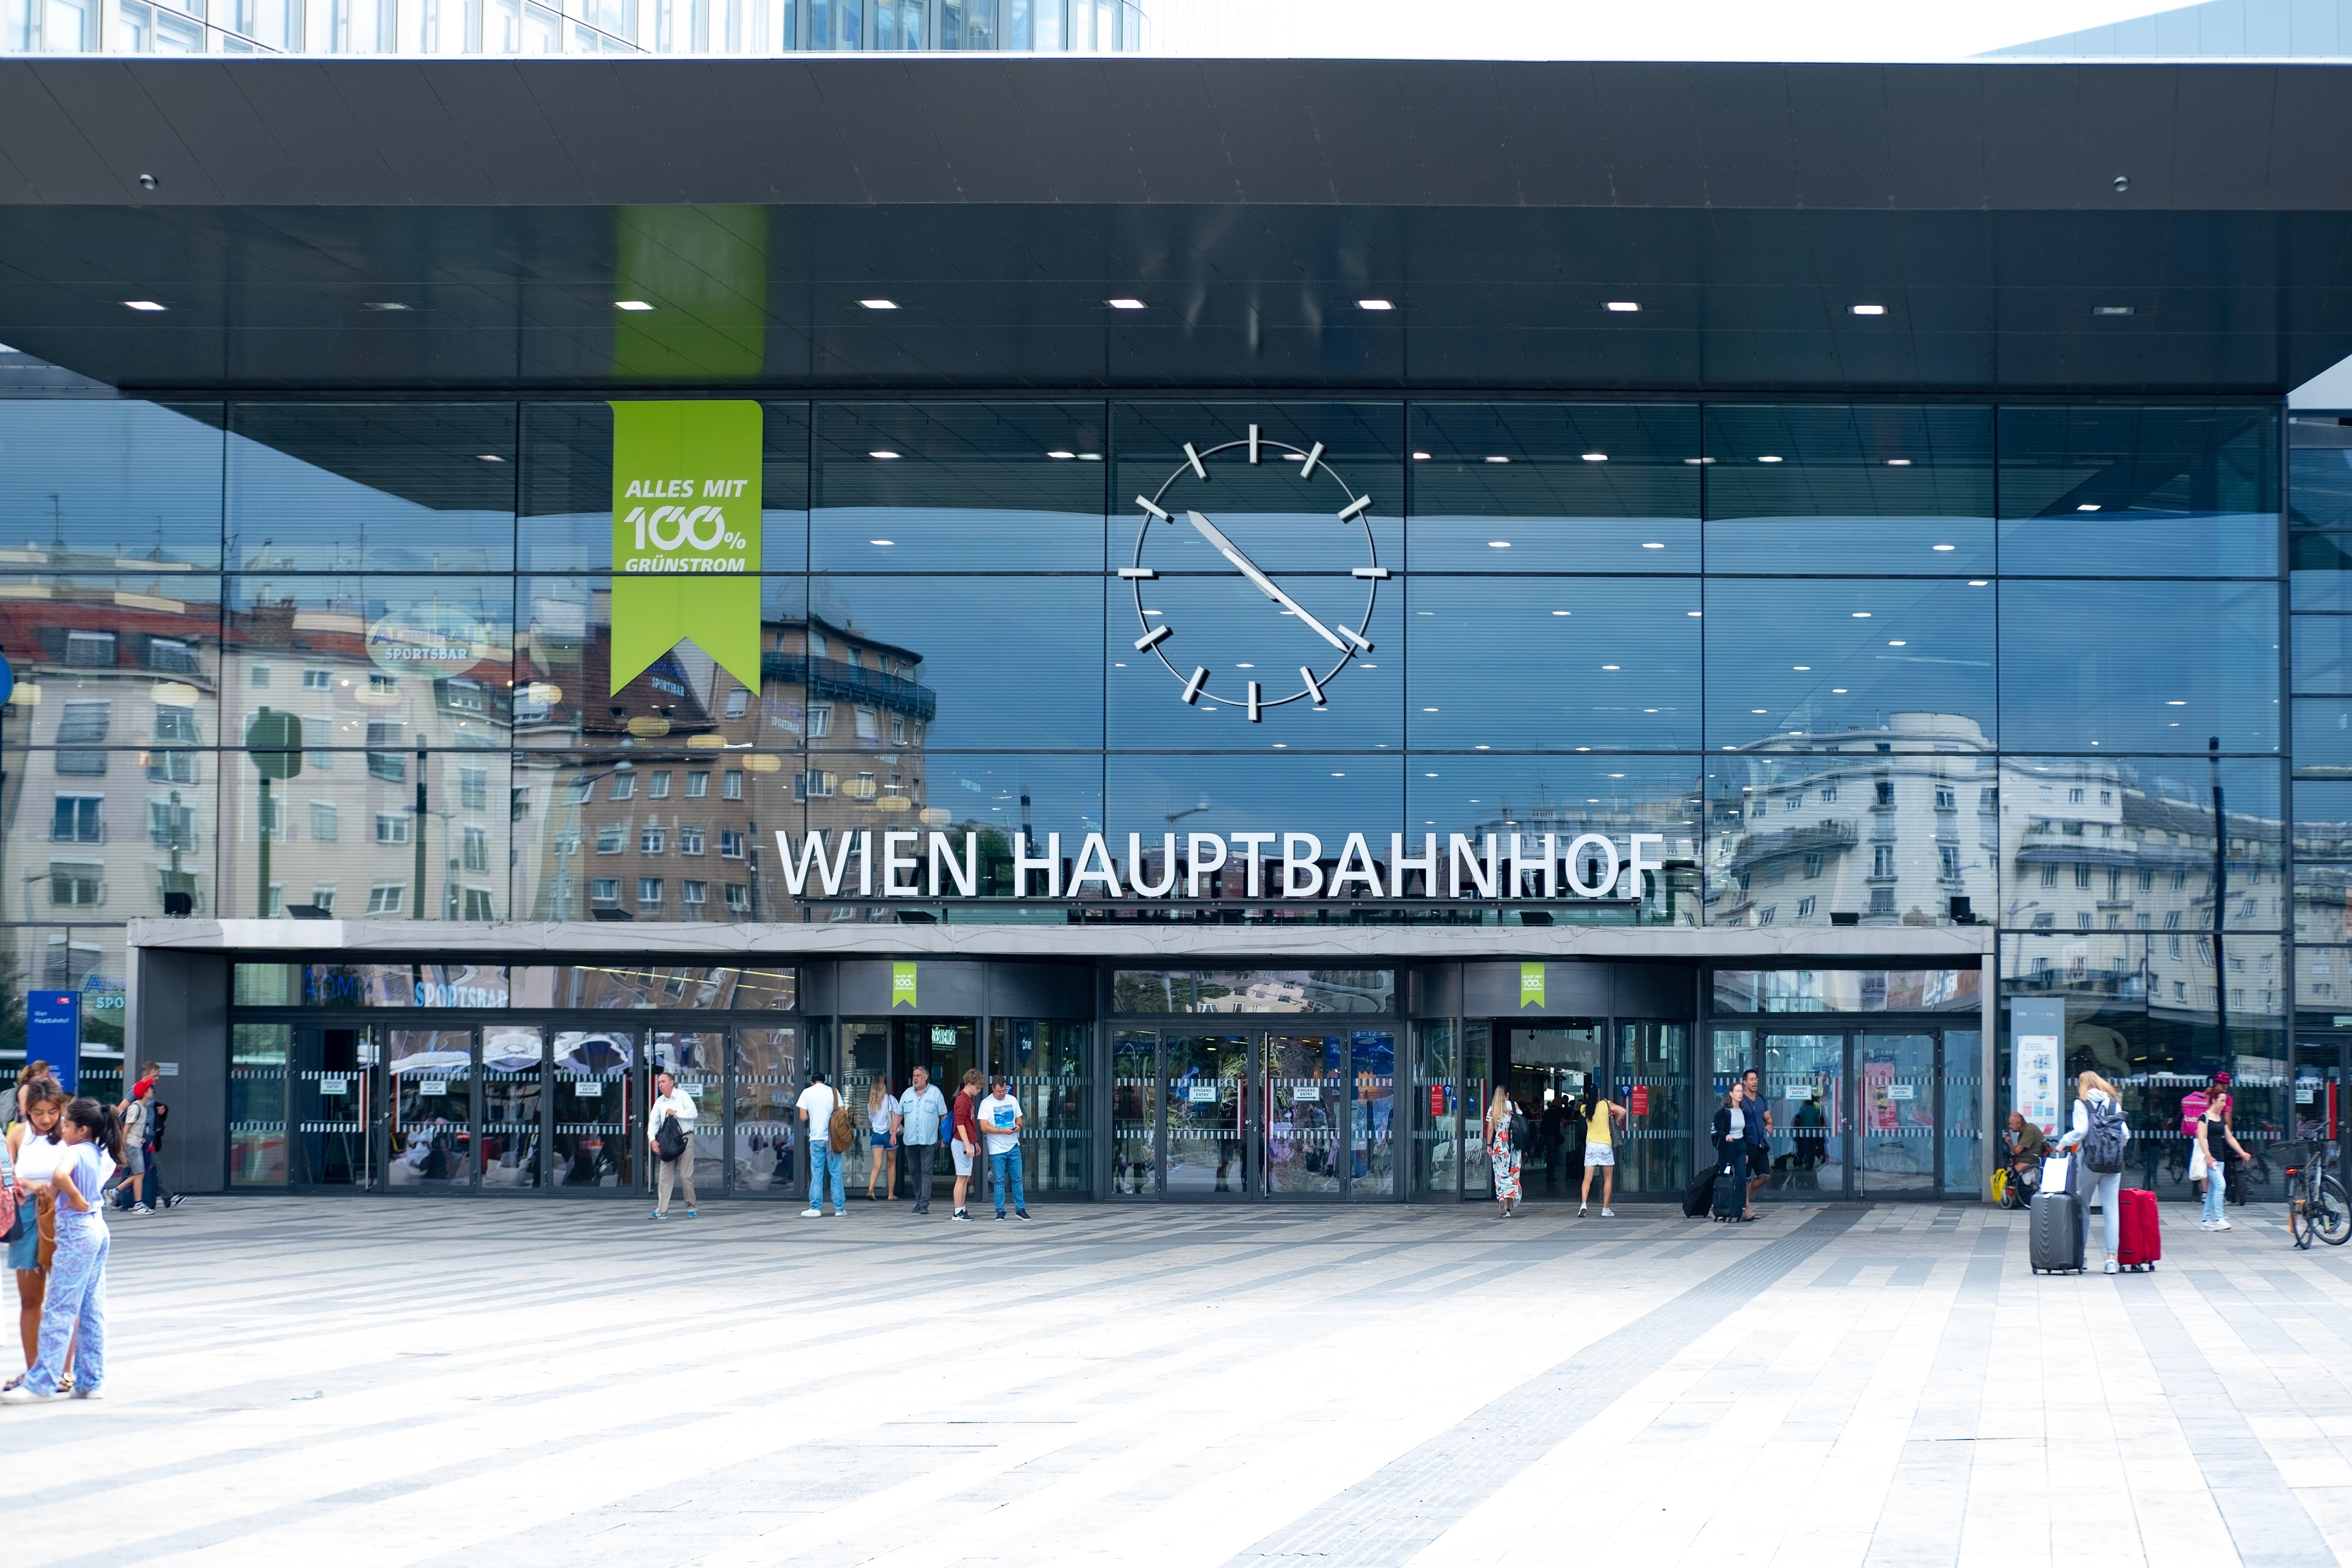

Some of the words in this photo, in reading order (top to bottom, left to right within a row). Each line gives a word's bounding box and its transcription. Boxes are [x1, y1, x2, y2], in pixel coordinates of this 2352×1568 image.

[625, 480, 694, 498] ALLES
[703, 480, 748, 498] MIT
[624, 505, 747, 550] 100%
[625, 555, 746, 572] GRÜNSTROM
[371, 625, 483, 645] ADMIRAL
[386, 648, 468, 660] SPORTSBAR
[651, 676, 685, 697] SPORTSBAR
[775, 831, 976, 896] WIEN
[1014, 832, 1663, 897] HAUPTBAHNHOF
[96, 997, 125, 1009] SPO
[415, 981, 508, 1008] SPORTSBAR
